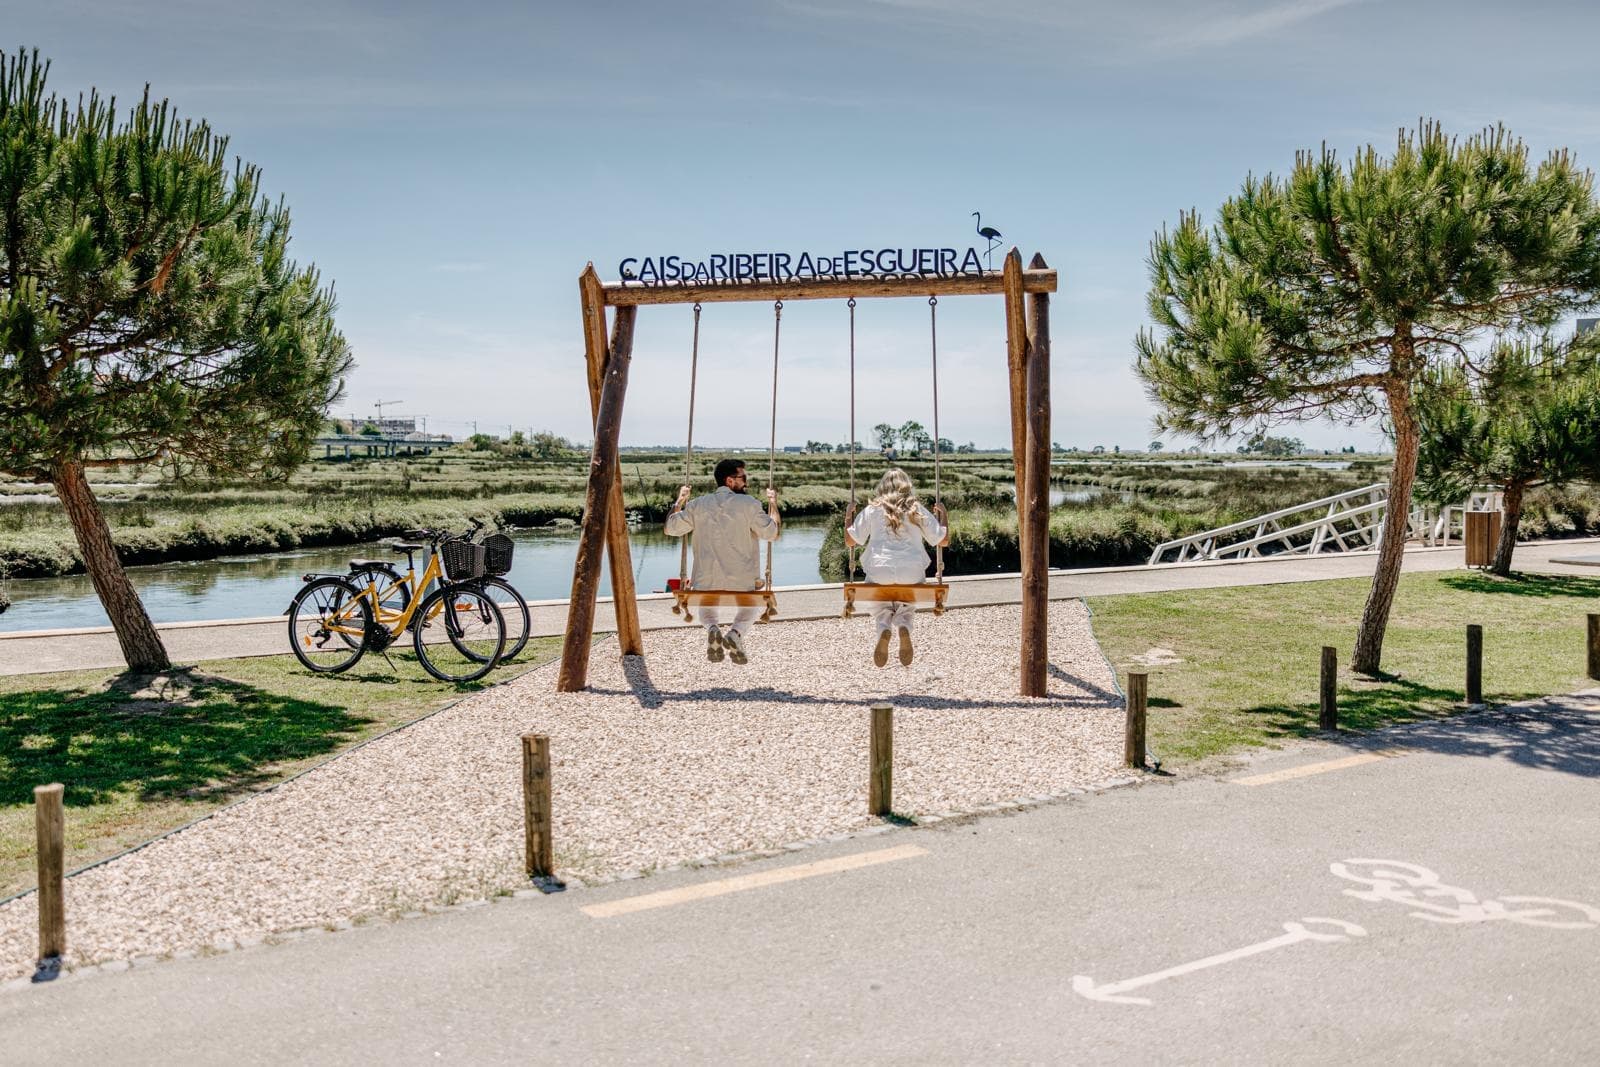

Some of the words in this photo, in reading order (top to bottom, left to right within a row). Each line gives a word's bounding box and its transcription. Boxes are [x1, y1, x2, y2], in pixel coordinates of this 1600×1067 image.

[619, 256, 681, 280] CAIS
[681, 262, 710, 280] DA
[710, 252, 816, 278] RIBEIRA
[817, 257, 843, 275] DE
[844, 247, 983, 275] ESGUEIRA
